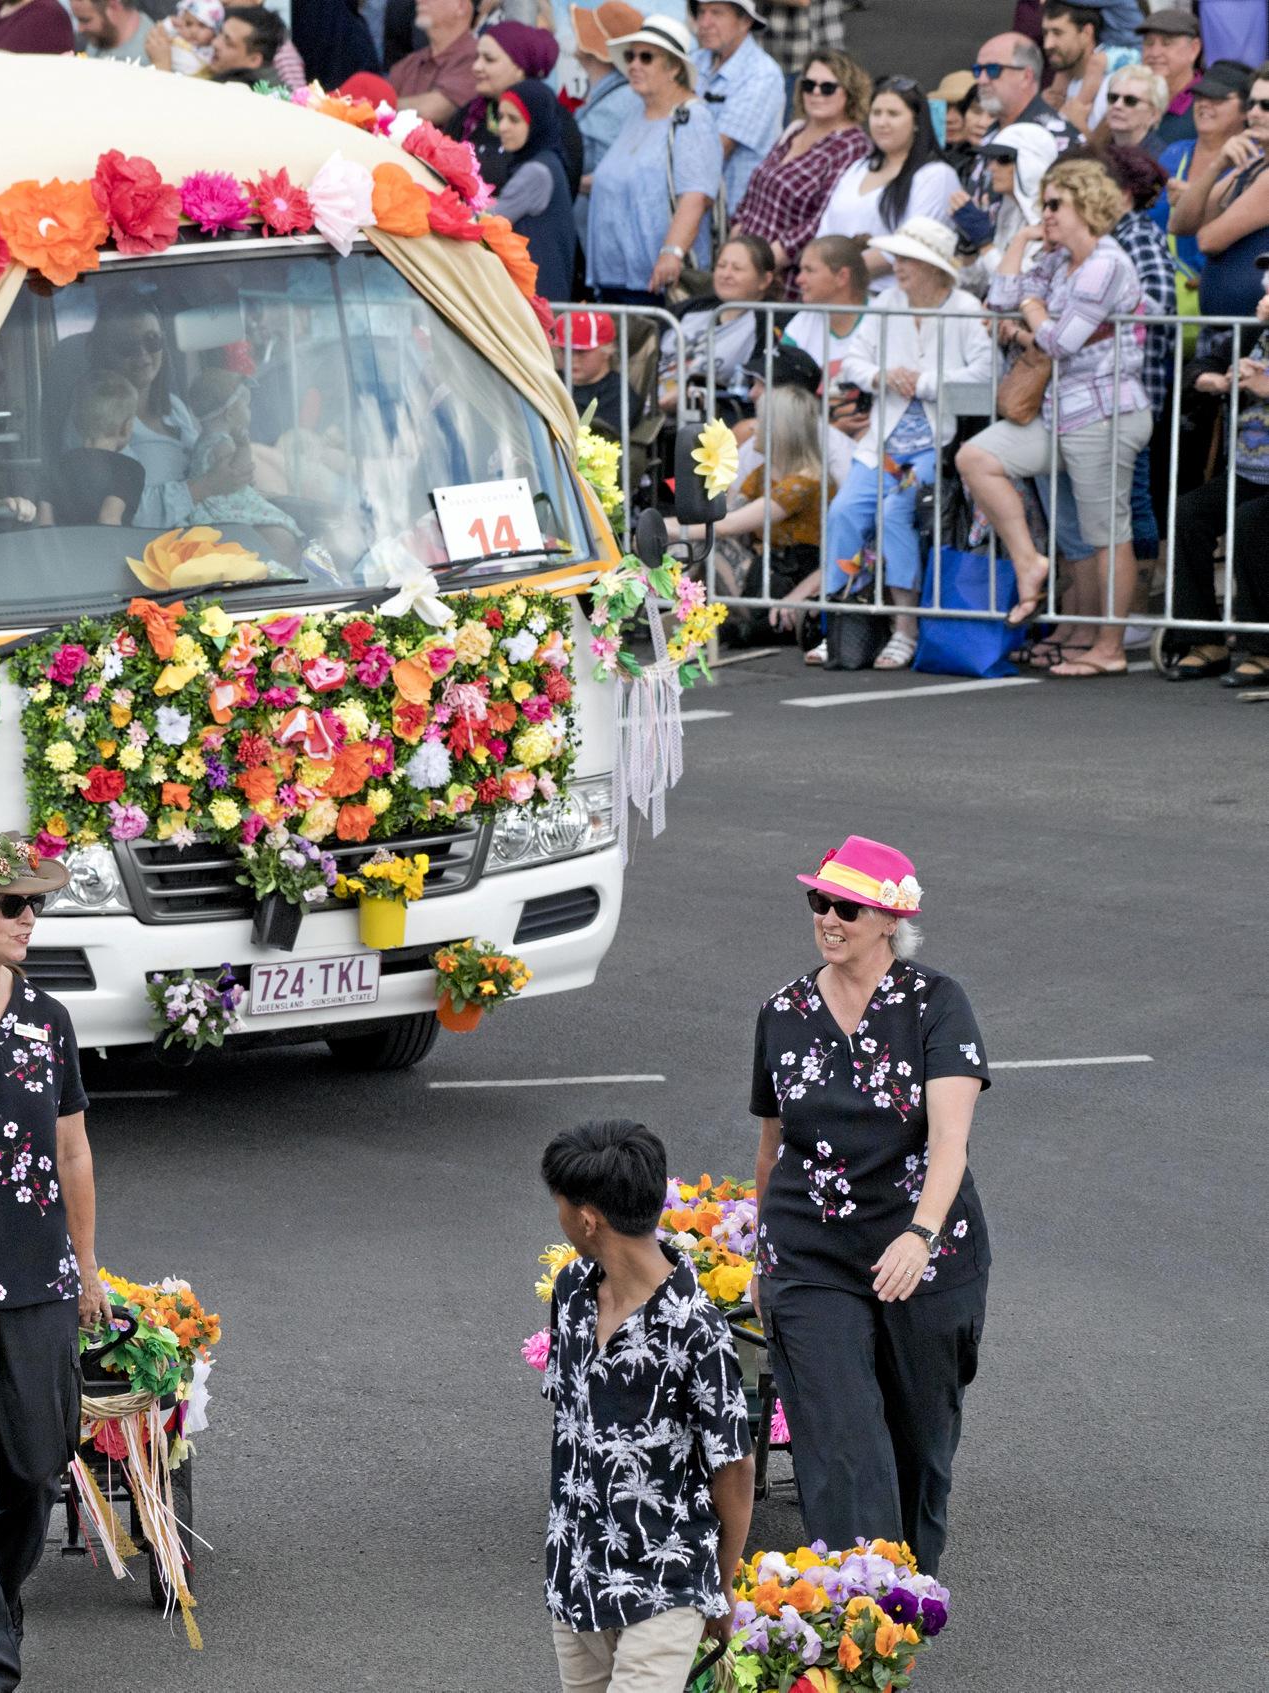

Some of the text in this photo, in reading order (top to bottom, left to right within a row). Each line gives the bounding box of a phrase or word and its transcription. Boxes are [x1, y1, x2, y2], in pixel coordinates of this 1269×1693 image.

[468, 515, 521, 555] 14
[256, 1001, 304, 1013] QUEENSLAND
[311, 998, 347, 1007] SUNSHINE
